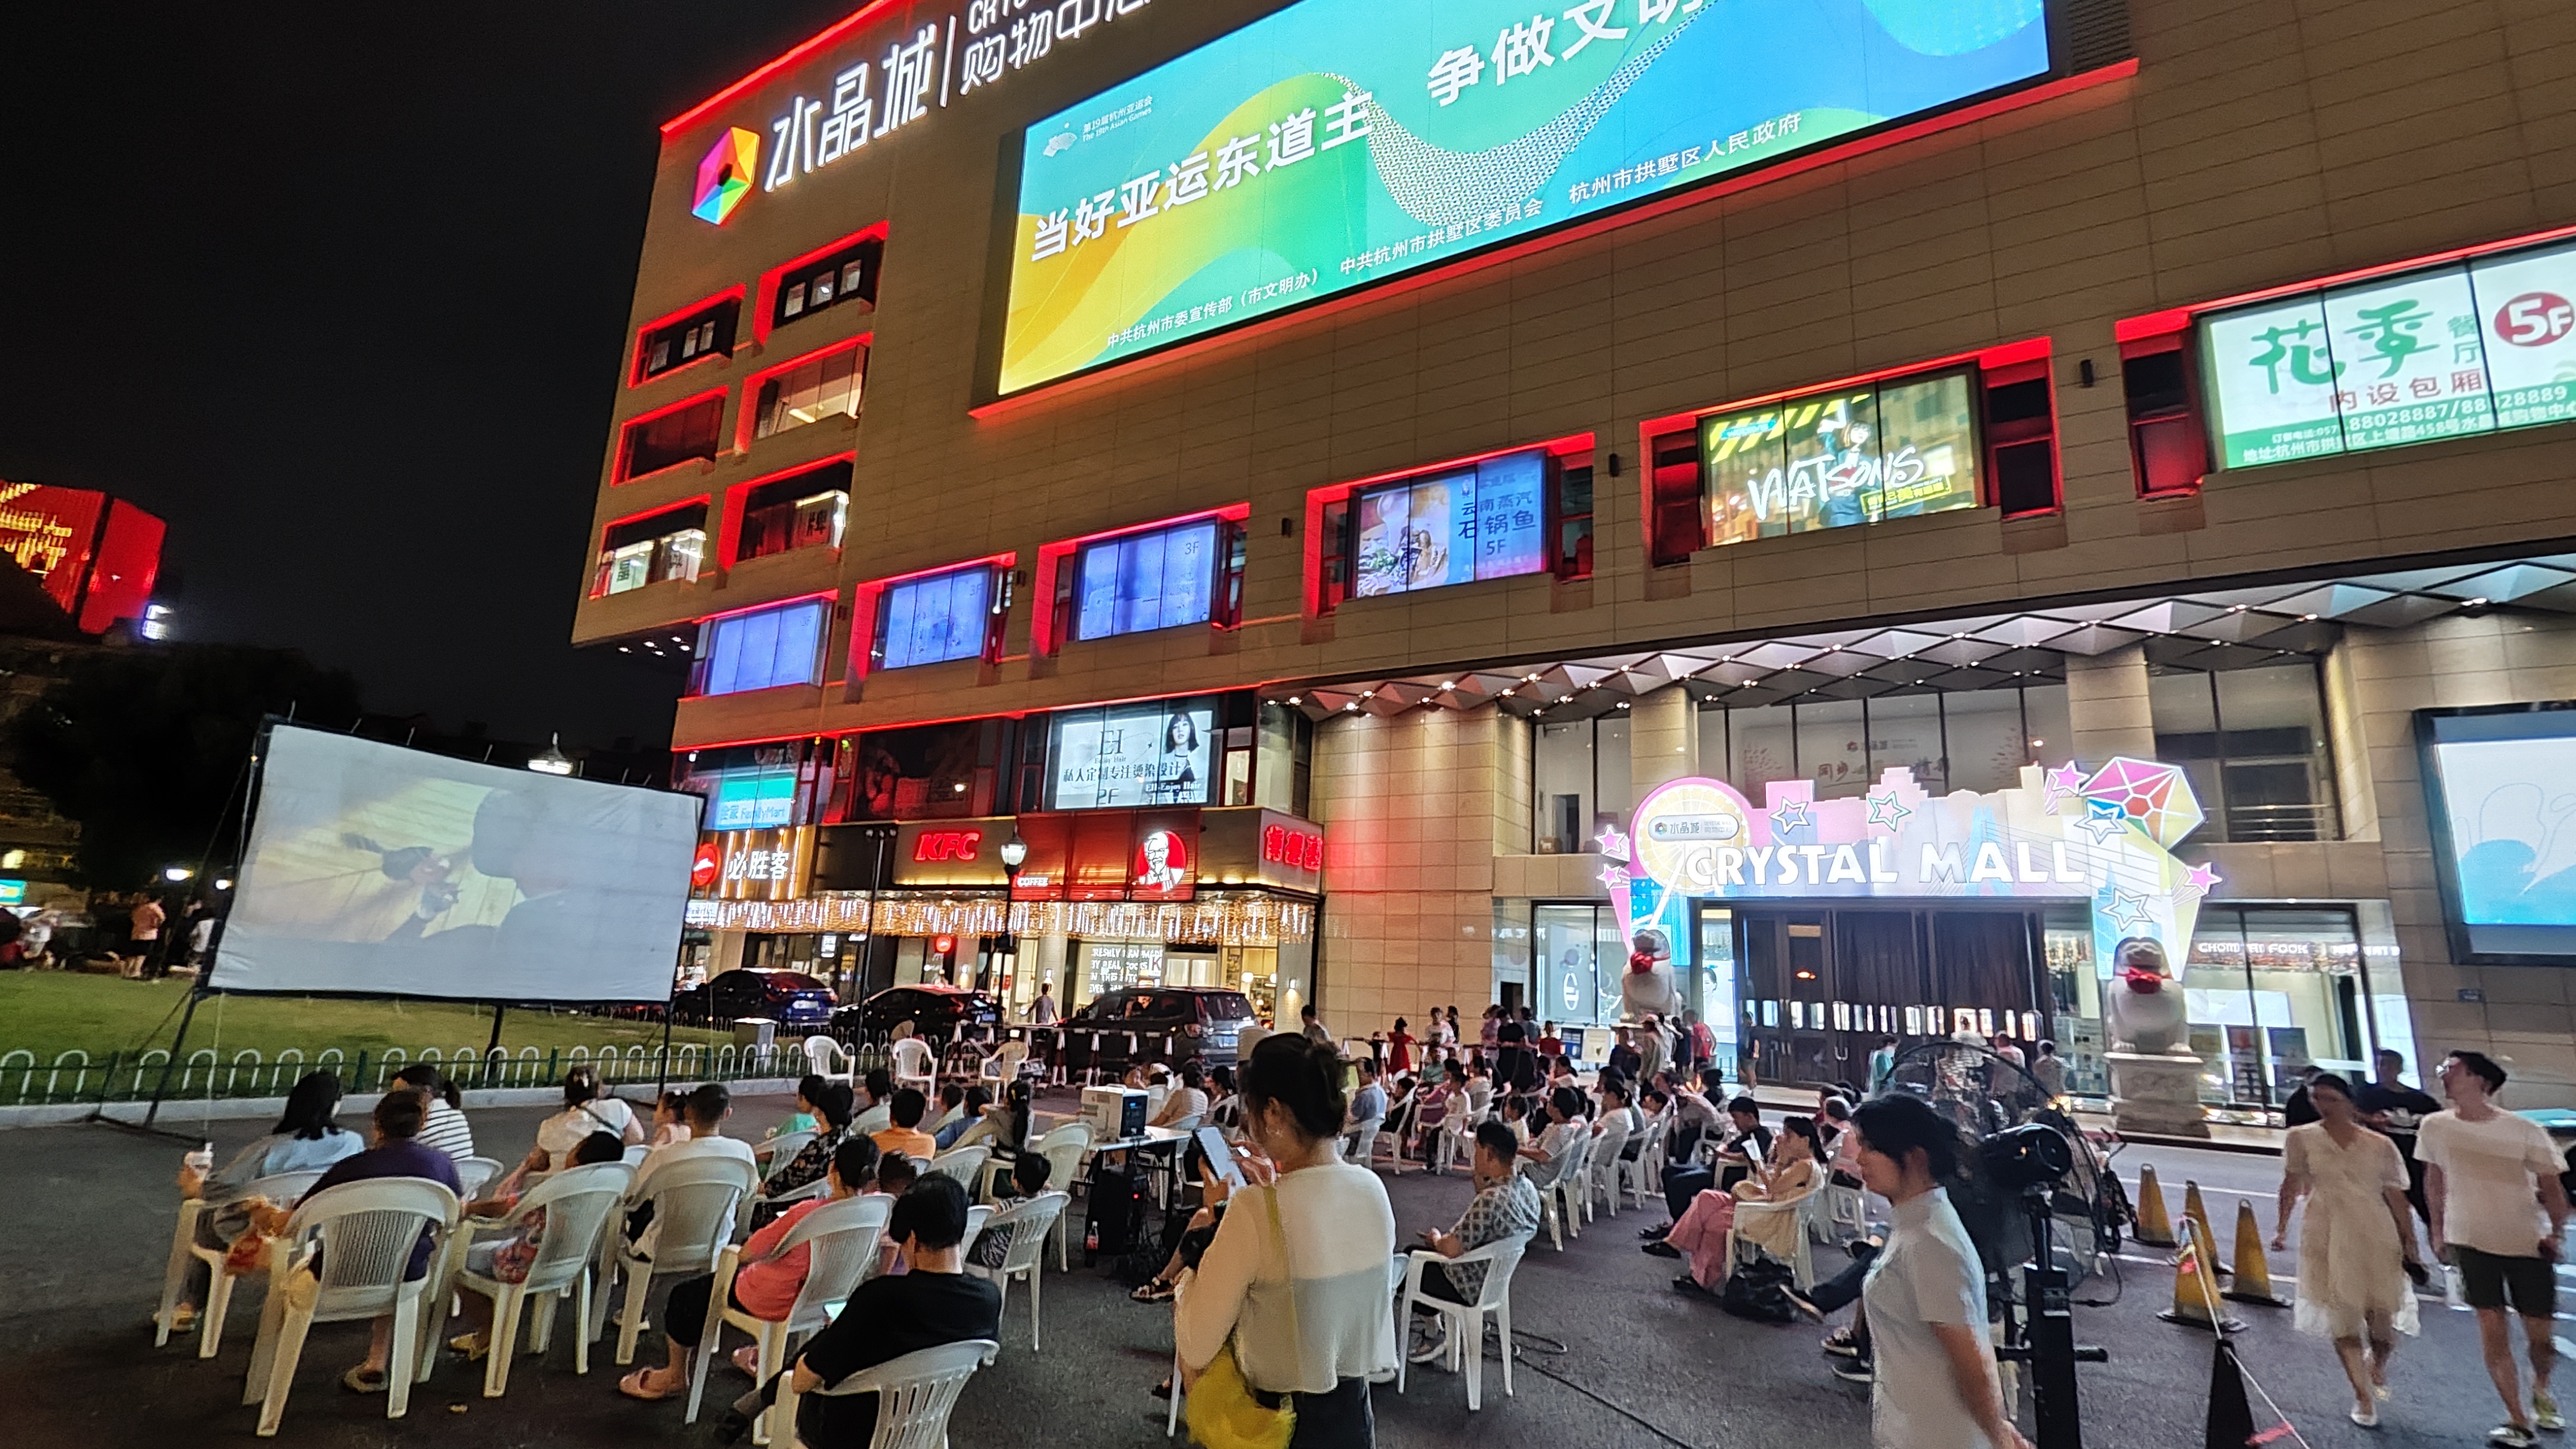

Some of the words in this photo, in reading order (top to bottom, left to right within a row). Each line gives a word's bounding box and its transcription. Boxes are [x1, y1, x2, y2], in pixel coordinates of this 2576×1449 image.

[763, 23, 937, 192] 水晶城
[1084, 96, 1153, 133] 第19届杭州亚运会
[1082, 131, 1094, 142] The
[1096, 126, 1109, 136] 19th
[1111, 118, 1128, 131] Asian
[1129, 108, 1152, 122] Games
[1031, 91, 1374, 262] 当好亚运东道主
[1340, 197, 1543, 275] 中共杭州市拱墅区委员会
[1569, 112, 1802, 203] 杭州市拱墅区人民政府
[2509, 298, 2571, 343] 5F
[2250, 299, 2440, 394] 花季
[2447, 314, 2480, 365] 餐厅
[2329, 369, 2483, 413] 内设包厢
[1748, 447, 1923, 520] WATSONS
[1458, 510, 1536, 539] 石锅鱼
[1185, 541, 1200, 555] 3F
[1487, 539, 1506, 555] 5F
[1063, 762, 1180, 783] 私人定制专注烫染设计
[1183, 781, 1201, 790] Hair
[1098, 788, 1119, 805] 2F
[1670, 822, 1699, 834] 水晶城
[915, 832, 981, 862] KFC
[728, 851, 789, 880] 必胜客
[1685, 844, 1898, 886] CRYSTAL
[1919, 841, 2086, 884] MALL
[1017, 877, 1049, 887] COFFEE
[2268, 943, 2309, 954] FOOK
